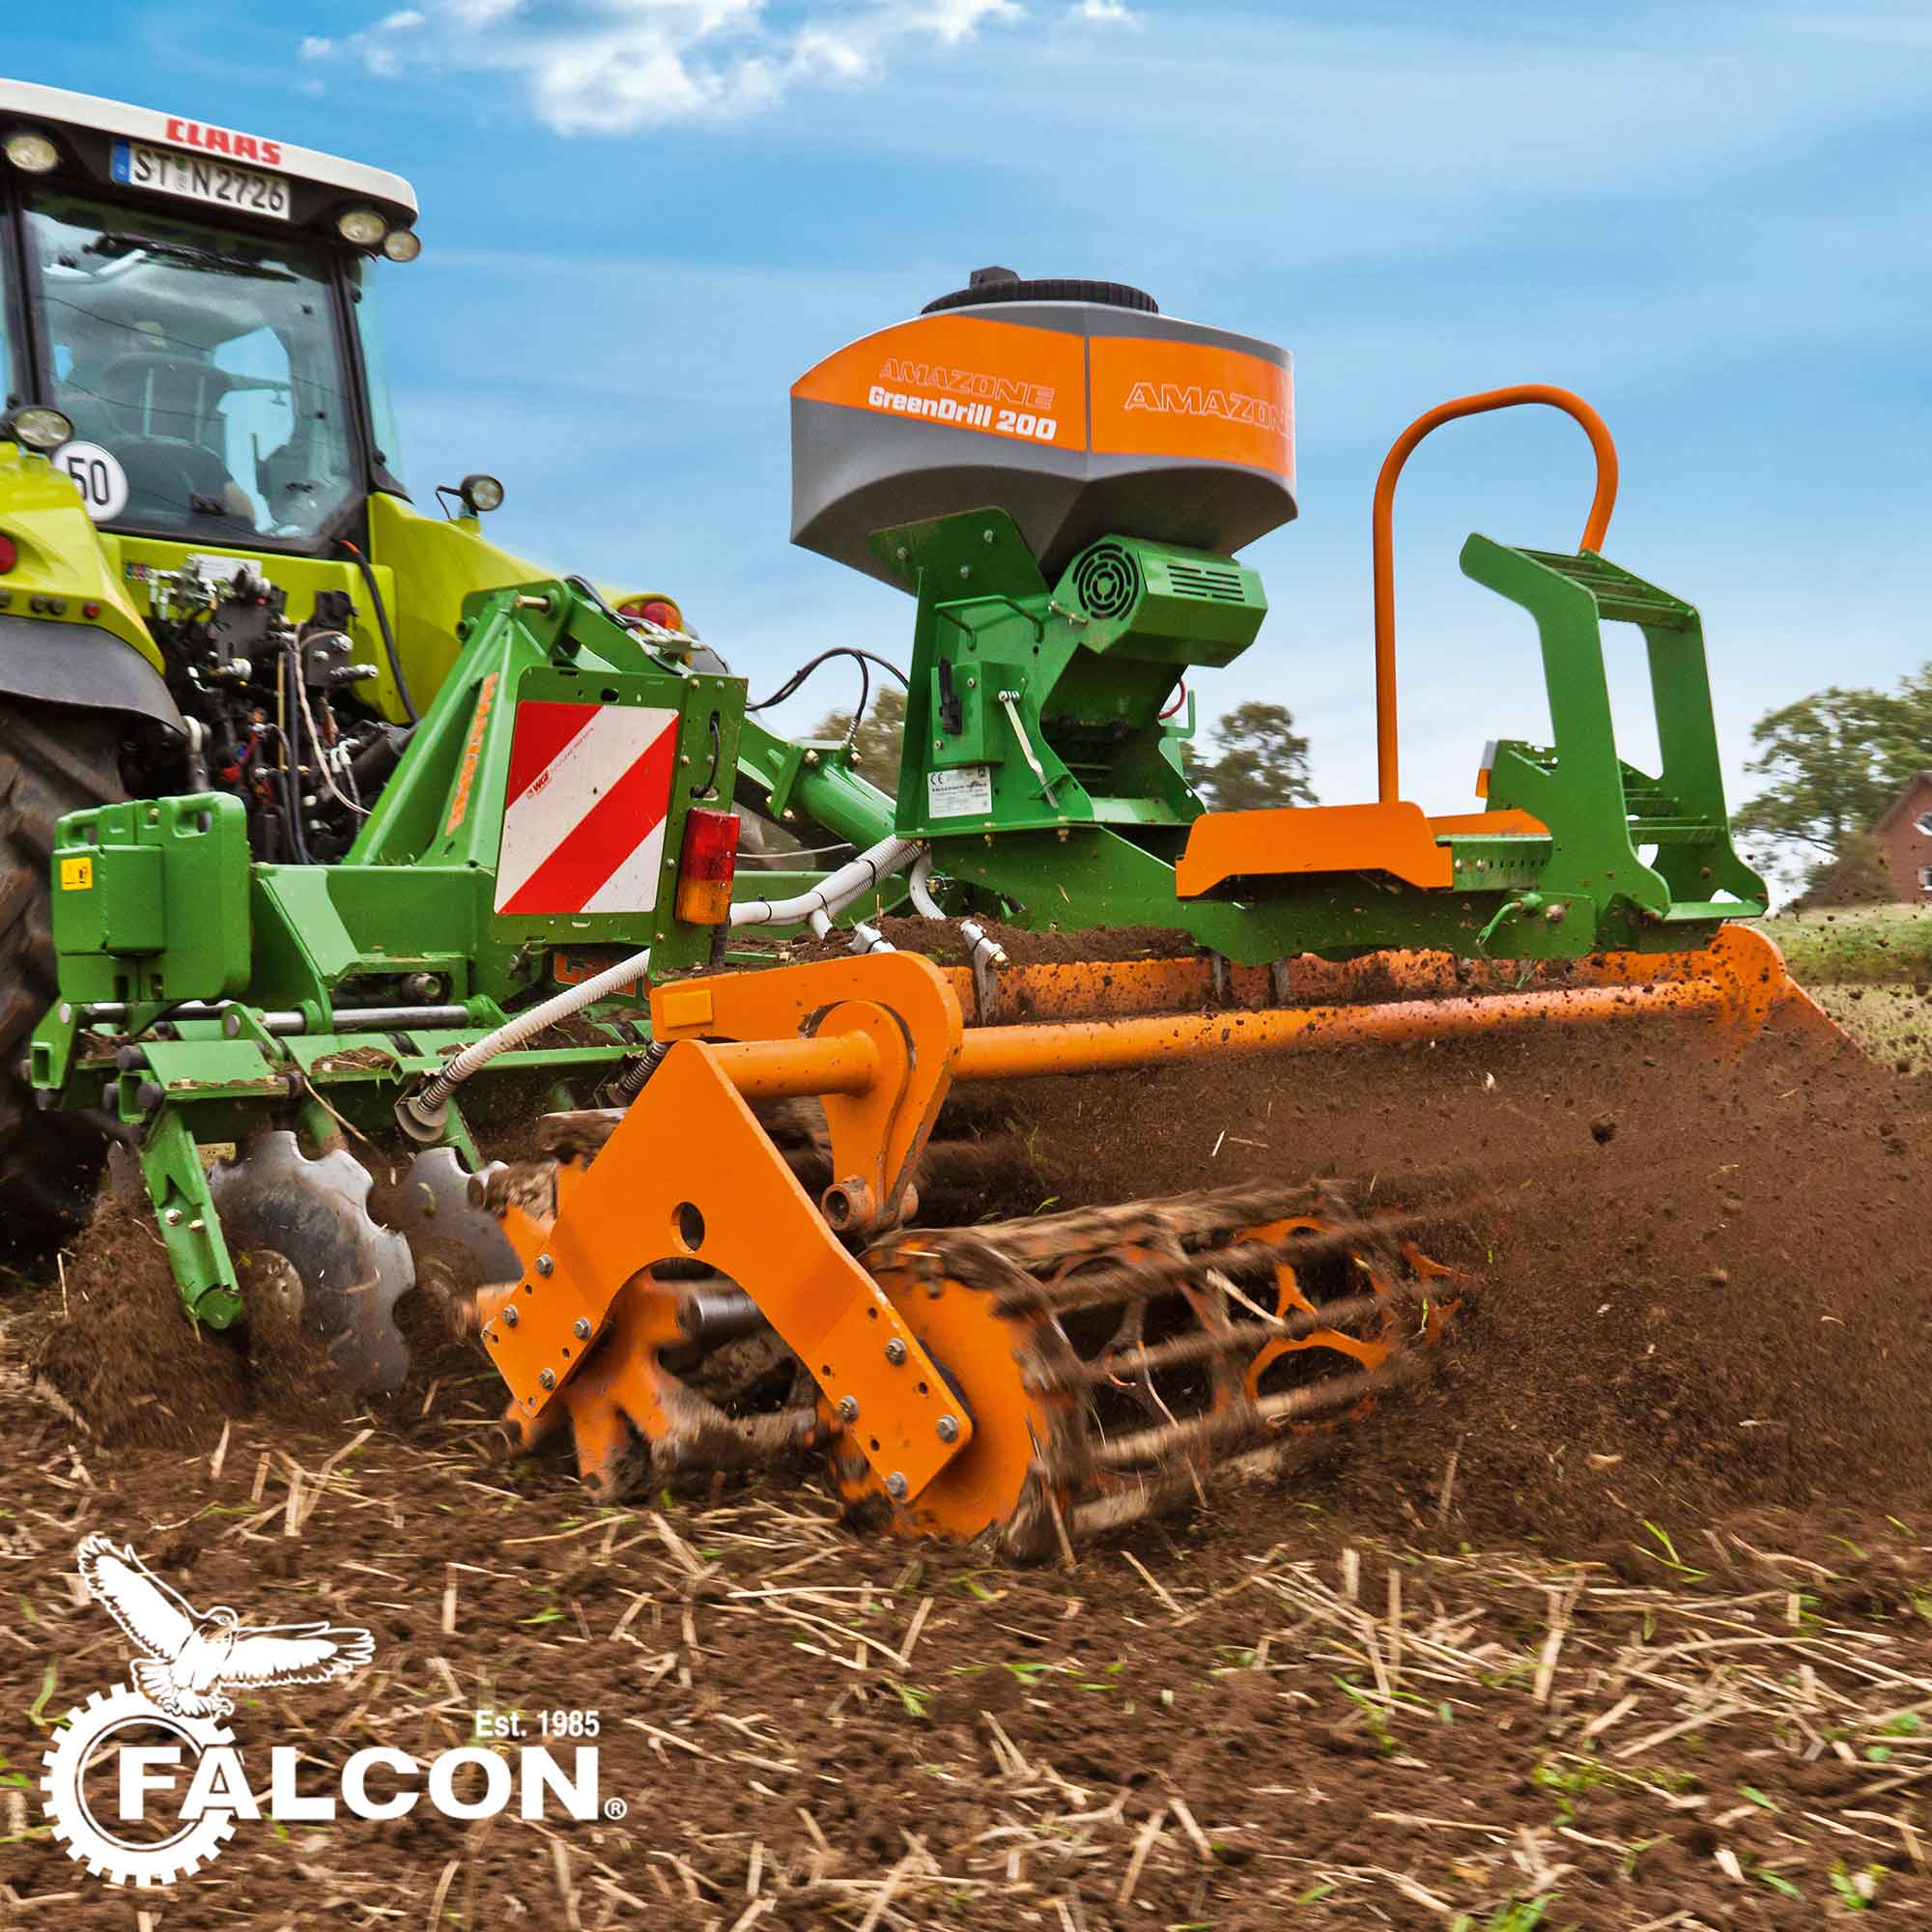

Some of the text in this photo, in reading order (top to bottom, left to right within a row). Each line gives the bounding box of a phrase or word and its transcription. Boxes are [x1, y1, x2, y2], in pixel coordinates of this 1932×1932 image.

[166, 117, 282, 166] CLAAS
[878, 357, 1056, 411] AMAZONE
[867, 385, 1058, 441] GreenDrill 200
[67, 455, 110, 506] 50
